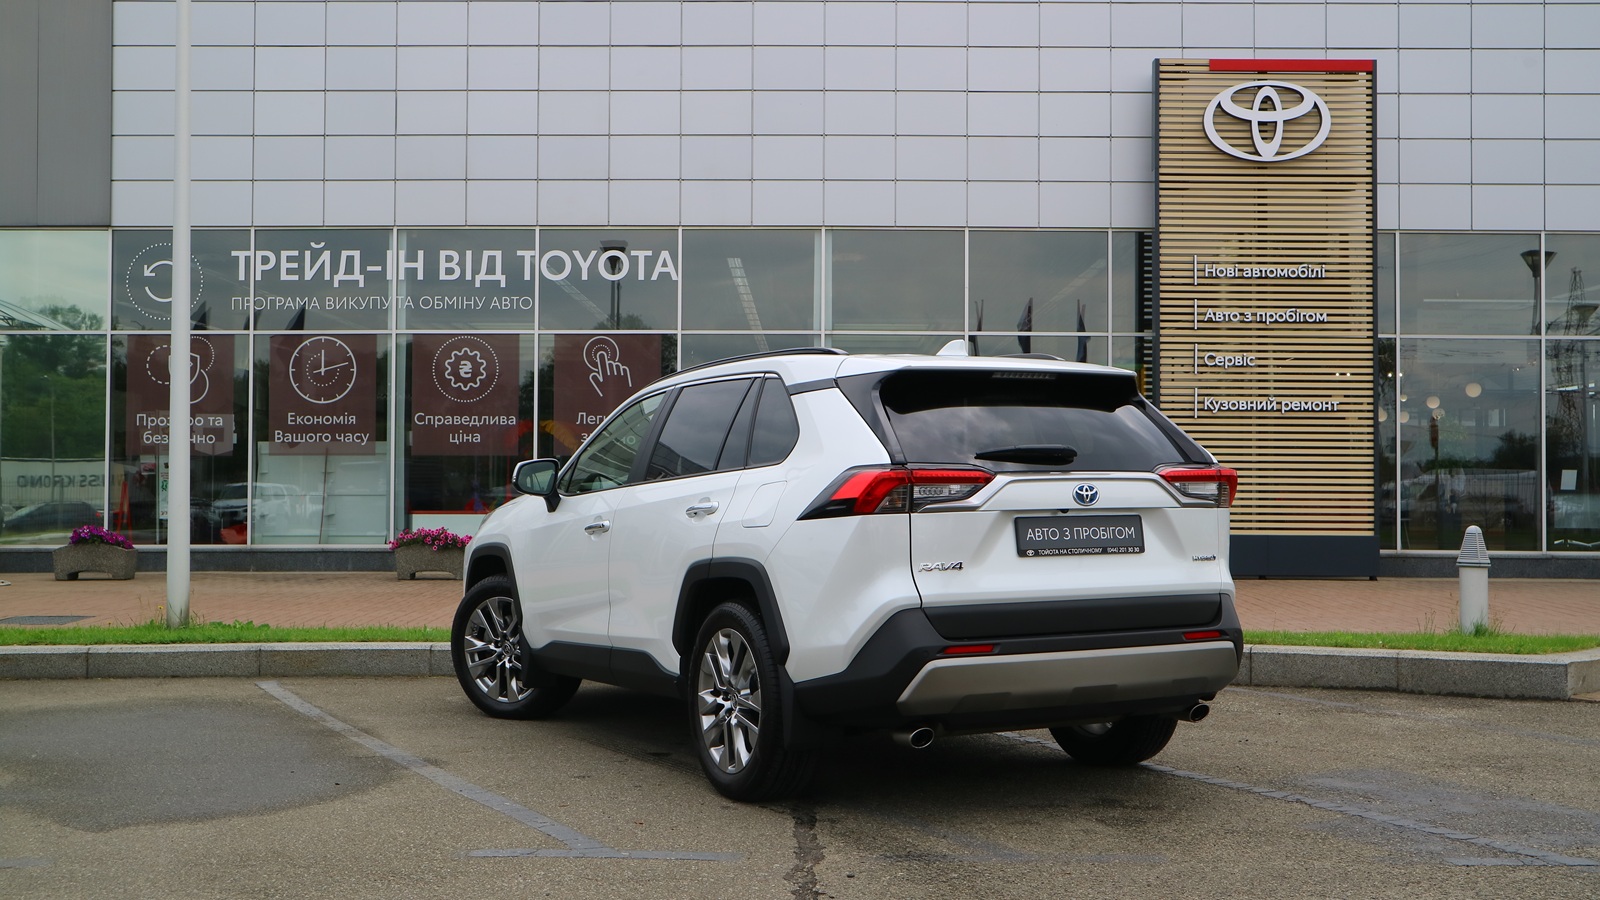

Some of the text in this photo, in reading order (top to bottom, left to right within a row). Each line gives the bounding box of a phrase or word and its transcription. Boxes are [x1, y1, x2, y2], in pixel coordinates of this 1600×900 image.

[231, 242, 679, 288] ТРЕЙД-ІН ВІД TOYOTA
[1204, 264, 1326, 278] Нові автомобілі
[231, 295, 533, 310] ПРОГРАМА ВИКУПУ ТА ОБМІНУ АВТО
[1204, 308, 1328, 325] Авто з пробігом
[1204, 353, 1256, 369] Сервіс
[1204, 397, 1340, 414] Кузовний ремонт
[208, 416, 223, 426] та
[287, 412, 356, 425] Економія
[414, 412, 516, 428] Справедлива
[143, 430, 215, 444] безчно
[274, 430, 370, 446] Вашого часу
[449, 430, 481, 445] ціна
[1026, 526, 1136, 541] АВТО З ПРОБІГОМ
[918, 561, 964, 572] RAV4
